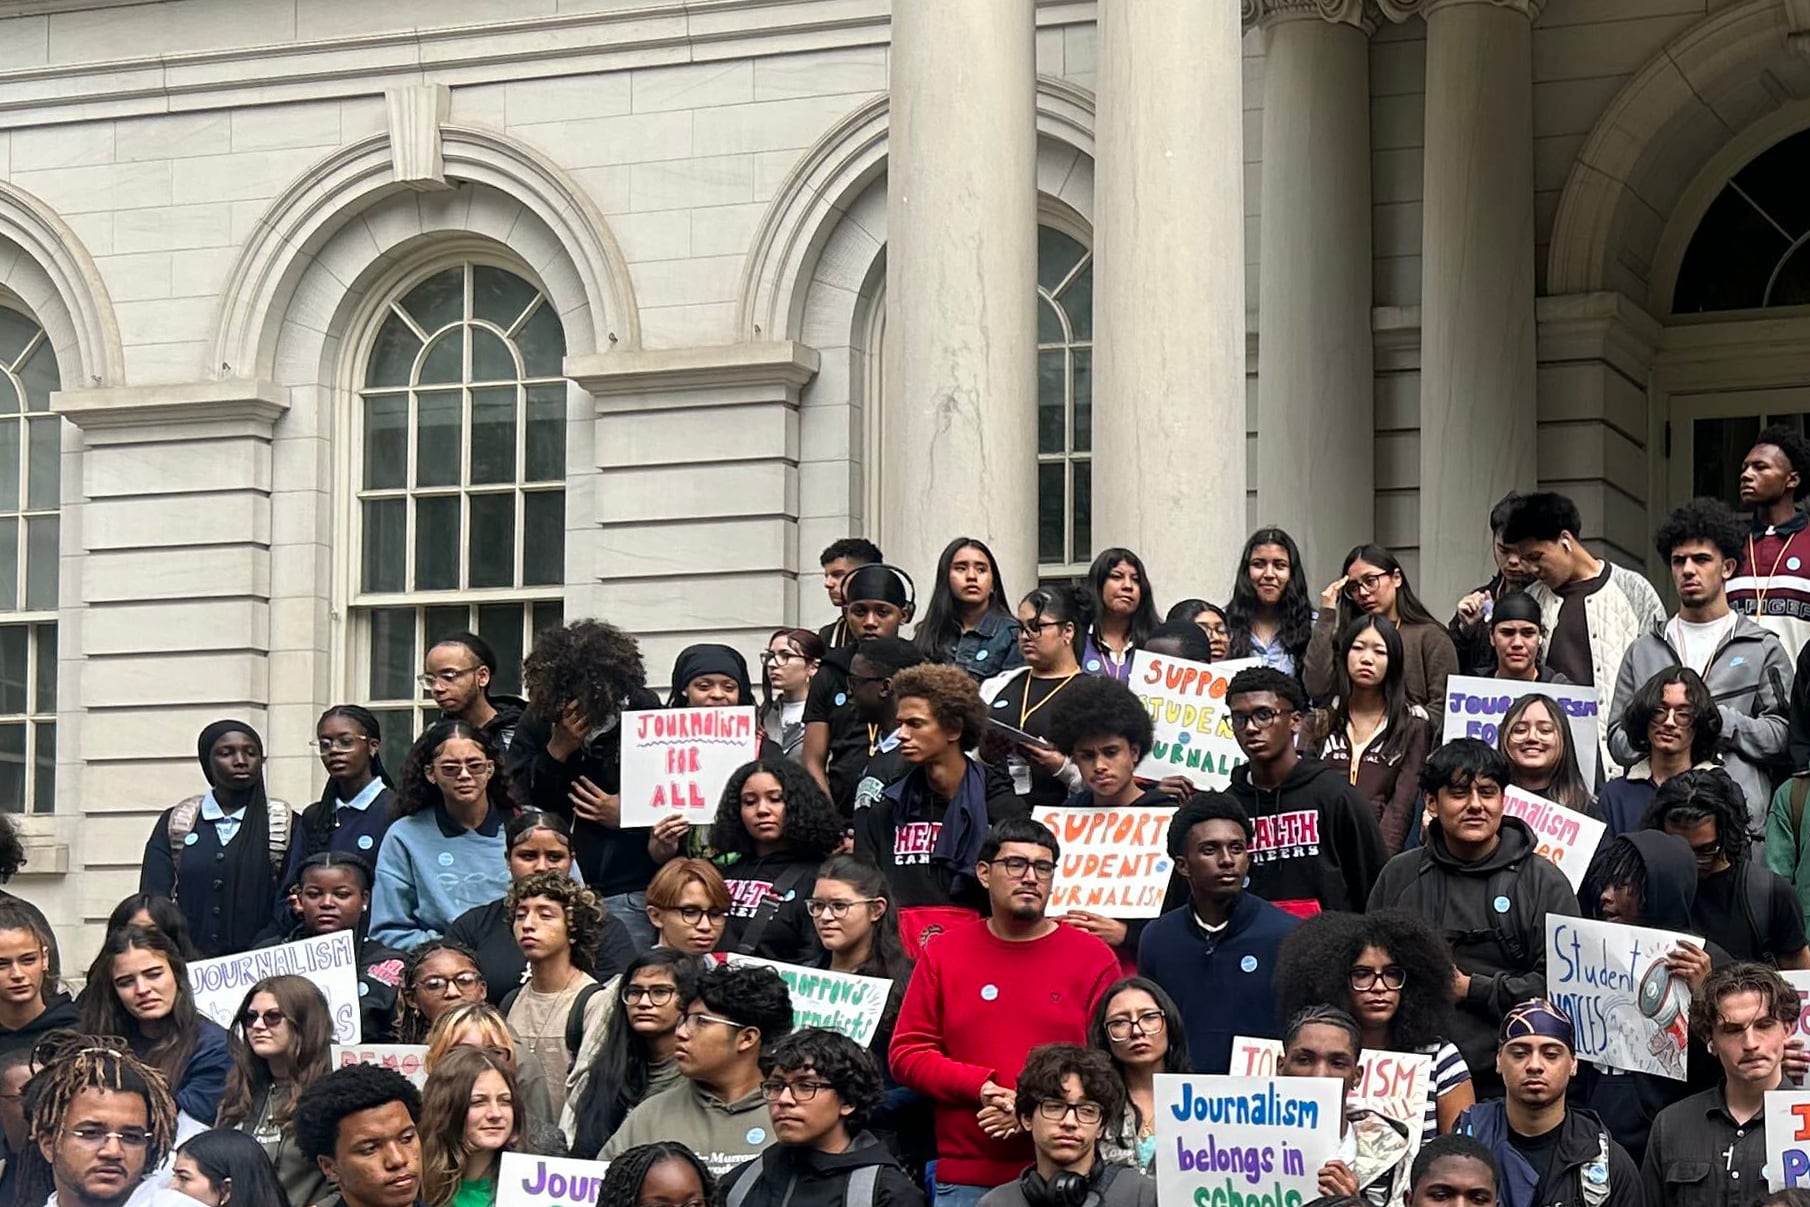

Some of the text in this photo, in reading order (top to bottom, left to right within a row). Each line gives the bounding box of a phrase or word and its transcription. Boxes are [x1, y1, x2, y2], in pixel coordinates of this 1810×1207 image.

[1144, 659, 1229, 699] SUPPO
[1465, 720, 1499, 747] FO
[666, 745, 701, 775] FOR
[650, 780, 706, 809] ALL
[1043, 811, 1172, 847] SUPPORT
[1061, 852, 1162, 879] UDENT
[1050, 884, 1166, 907] URNALISM
[192, 935, 353, 995] JOURNALISM
[1554, 924, 1642, 993] Student
[1171, 1082, 1319, 1129] Journalism
[1177, 1134, 1305, 1184] belongs in
